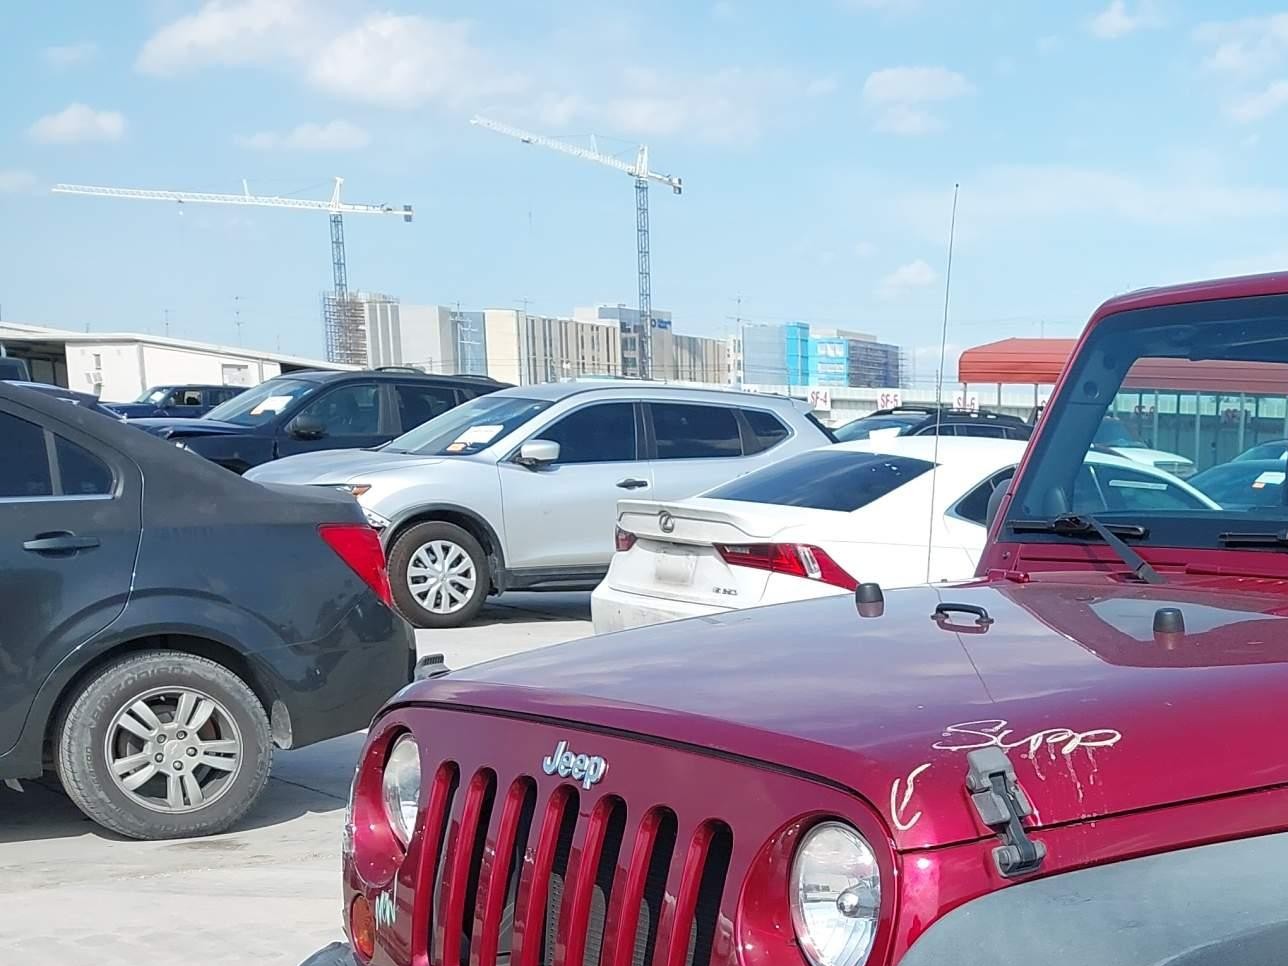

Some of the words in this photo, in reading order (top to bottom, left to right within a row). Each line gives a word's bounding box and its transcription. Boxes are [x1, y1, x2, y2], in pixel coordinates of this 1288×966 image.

[810, 391, 828, 408] SF-4
[880, 393, 898, 408] SF-5
[542, 739, 608, 790] Jeep
